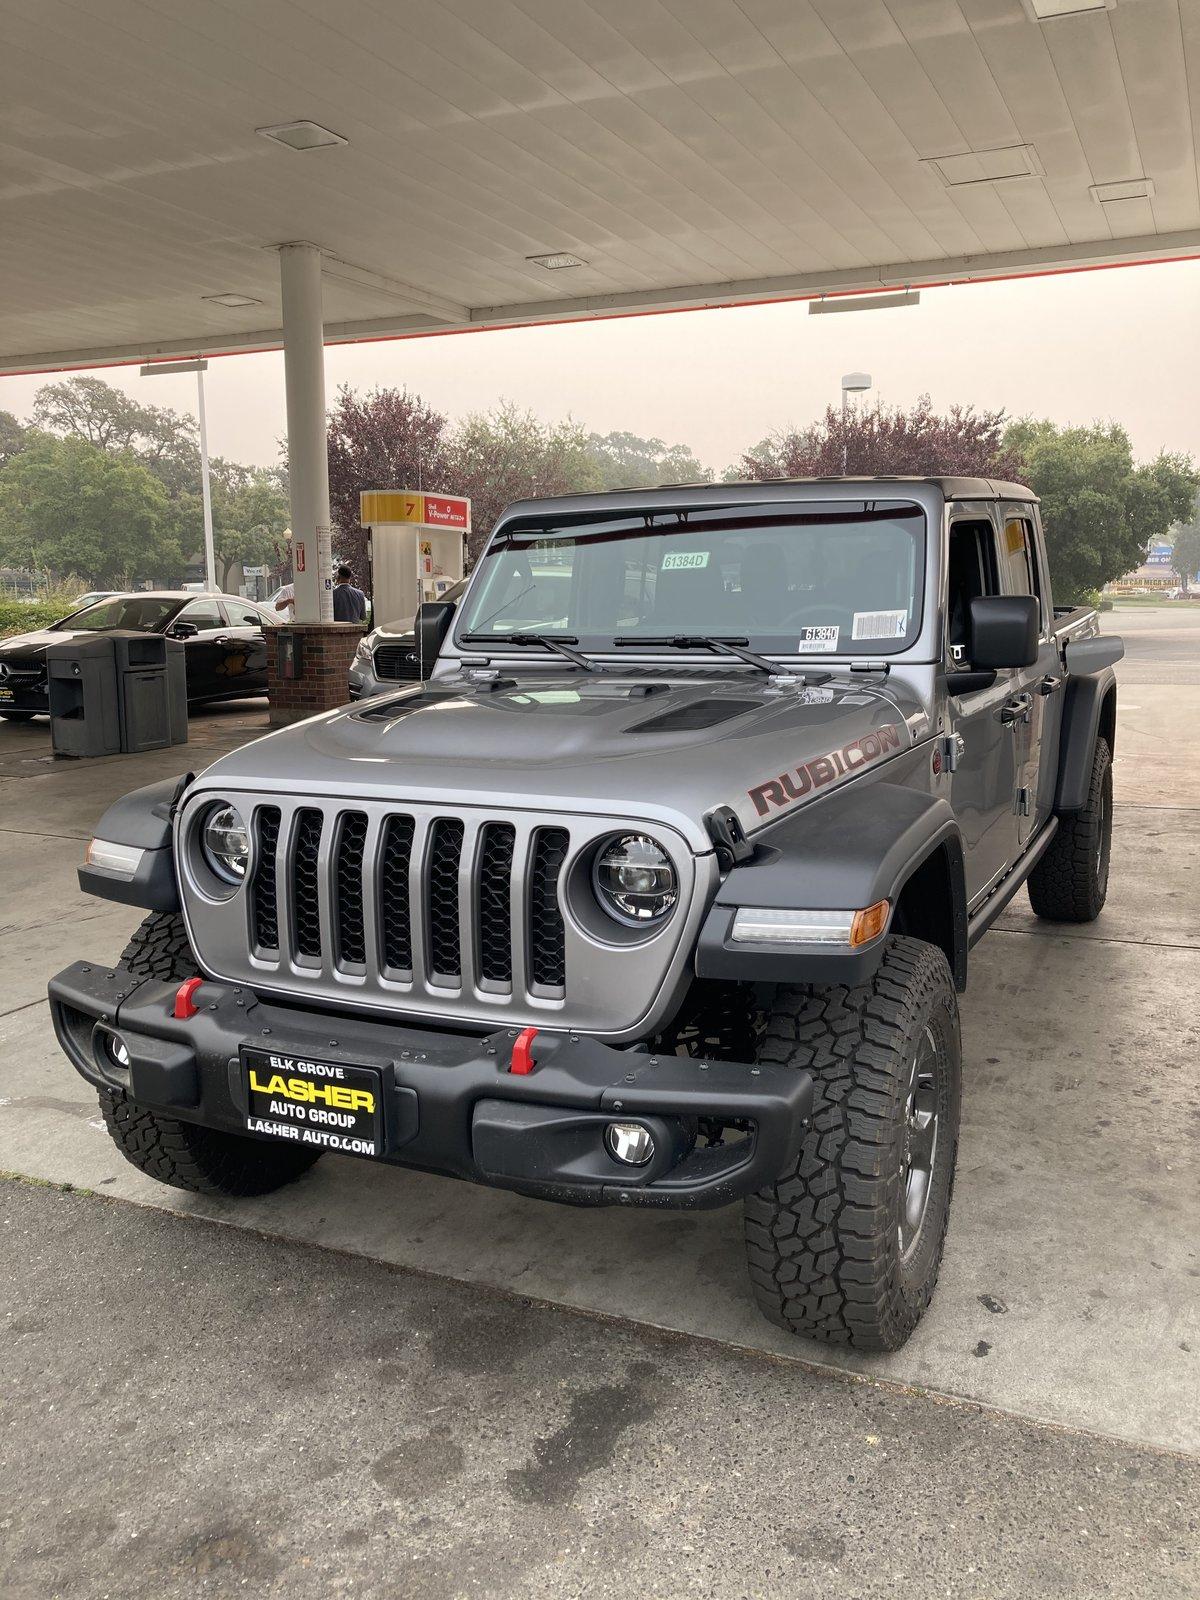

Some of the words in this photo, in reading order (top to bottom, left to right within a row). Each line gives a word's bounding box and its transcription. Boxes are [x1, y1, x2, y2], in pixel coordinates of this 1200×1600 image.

[406, 503, 415, 516] 7
[664, 555, 704, 568] 61384D
[805, 627, 837, 640] 61384D
[748, 724, 900, 816] RUBICON
[269, 1056, 295, 1071] ELK
[297, 1062, 345, 1079] GROVE
[249, 1070, 375, 1114] LASHER
[269, 1100, 306, 1120] AUTO
[308, 1108, 356, 1128] GROUP
[247, 1118, 299, 1140] LASHER
[302, 1130, 375, 1156] AUTO.COM
